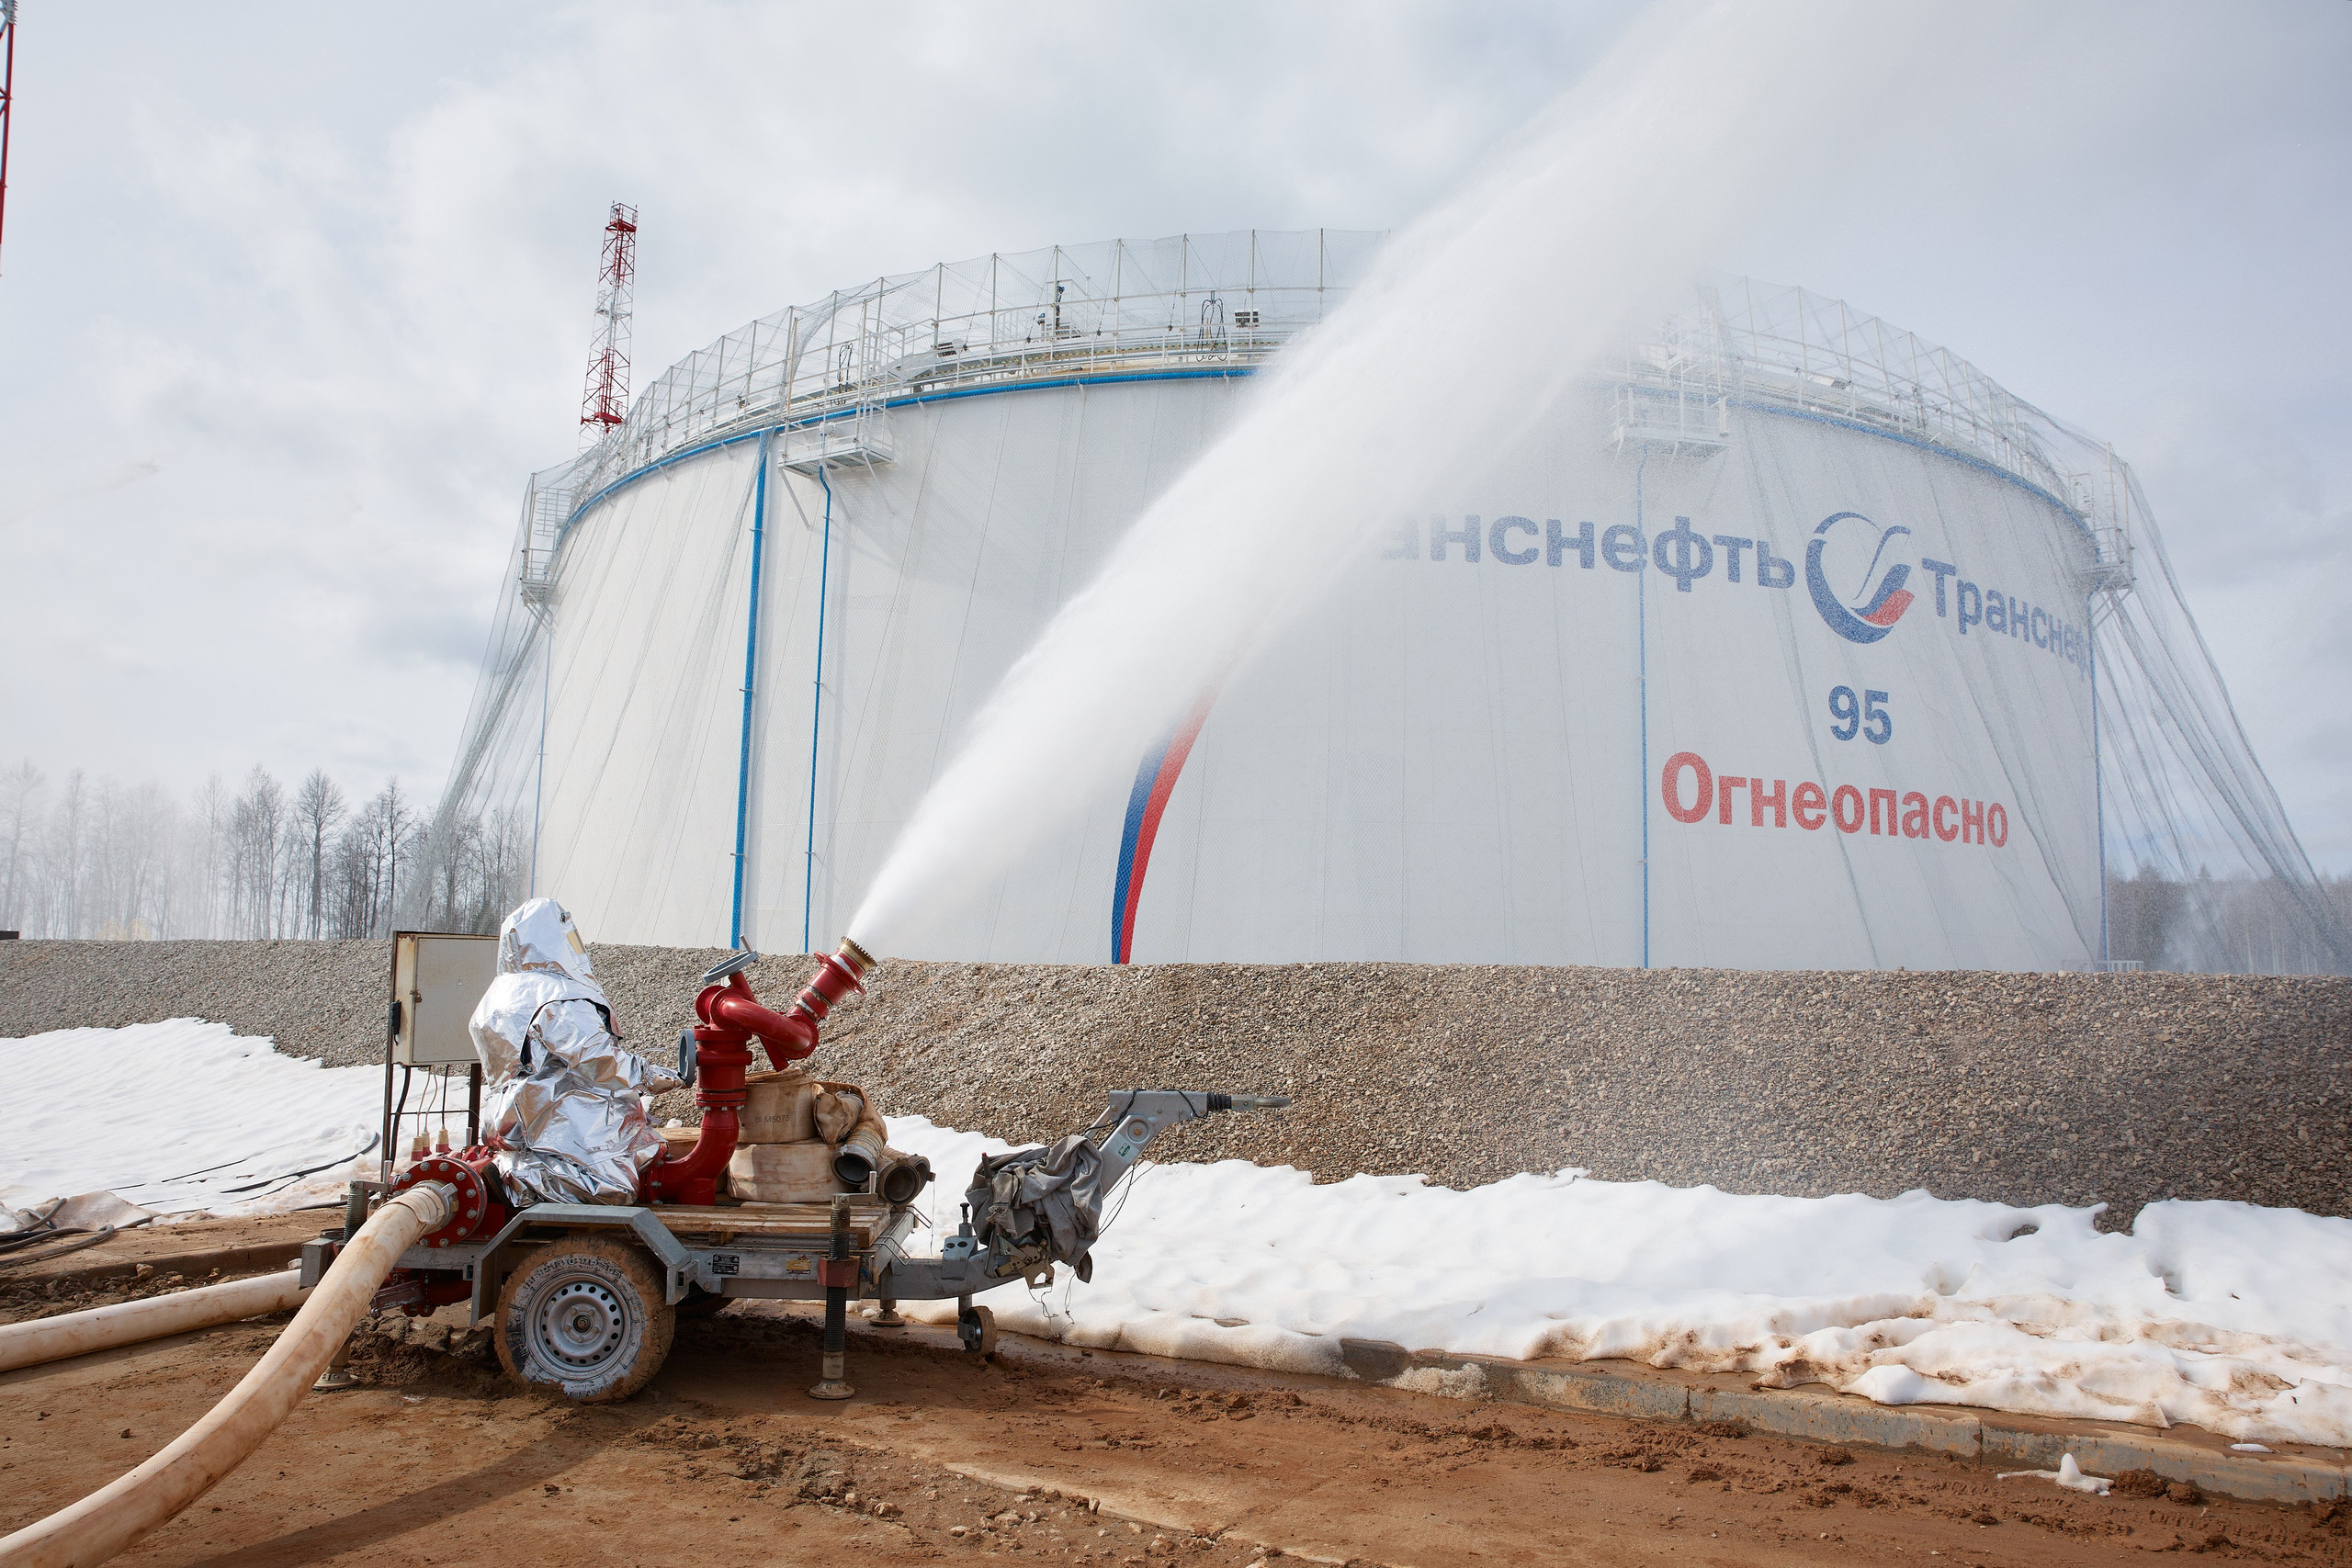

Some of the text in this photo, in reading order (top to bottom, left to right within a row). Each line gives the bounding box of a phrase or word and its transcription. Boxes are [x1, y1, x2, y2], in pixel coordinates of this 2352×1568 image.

[1377, 513, 1795, 592] анснефть
[1828, 685, 1892, 745] 95
[1661, 751, 2008, 848] Огнеопасно
